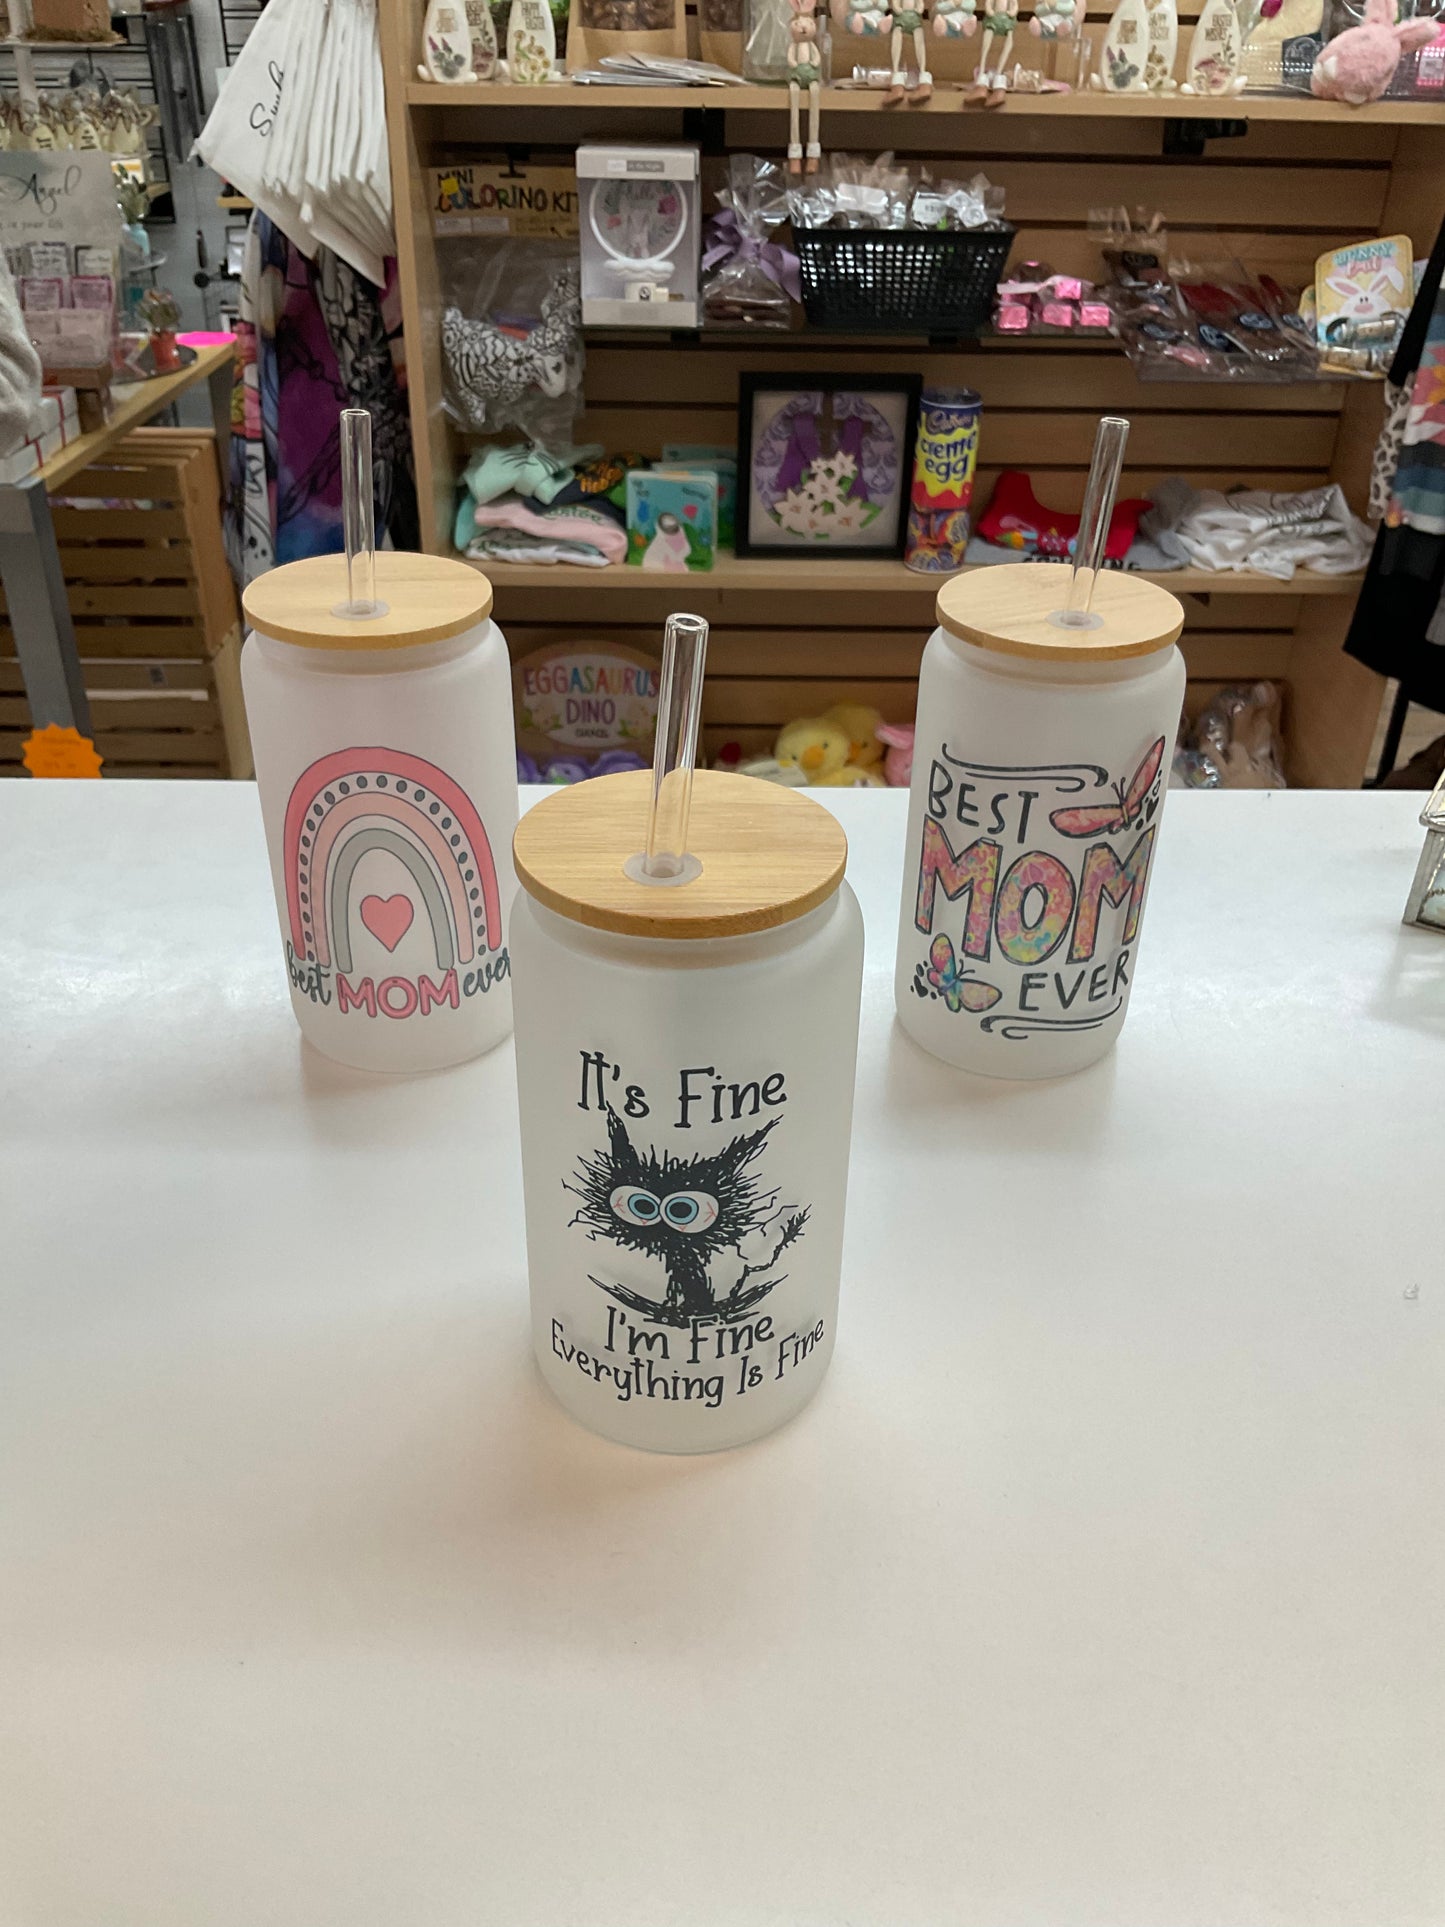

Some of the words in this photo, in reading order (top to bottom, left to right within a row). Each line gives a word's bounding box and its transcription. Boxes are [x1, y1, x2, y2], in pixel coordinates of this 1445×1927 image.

[925, 456, 969, 484] egg
[523, 665, 660, 698] EGGASAURUS
[566, 699, 616, 725] DINO
[928, 760, 1039, 844] BEST
[915, 814, 1157, 966] MOM
[287, 940, 332, 1006] best
[335, 968, 460, 1019] MOM
[1018, 950, 1130, 1012] EVER
[577, 1050, 650, 1118] It's
[674, 1066, 788, 1128] Fine
[551, 1317, 725, 1408] Everything
[736, 1355, 764, 1395] Is
[774, 1318, 825, 1380] Fine
[604, 1305, 670, 1360] I'm
[686, 1314, 775, 1364] Fine
